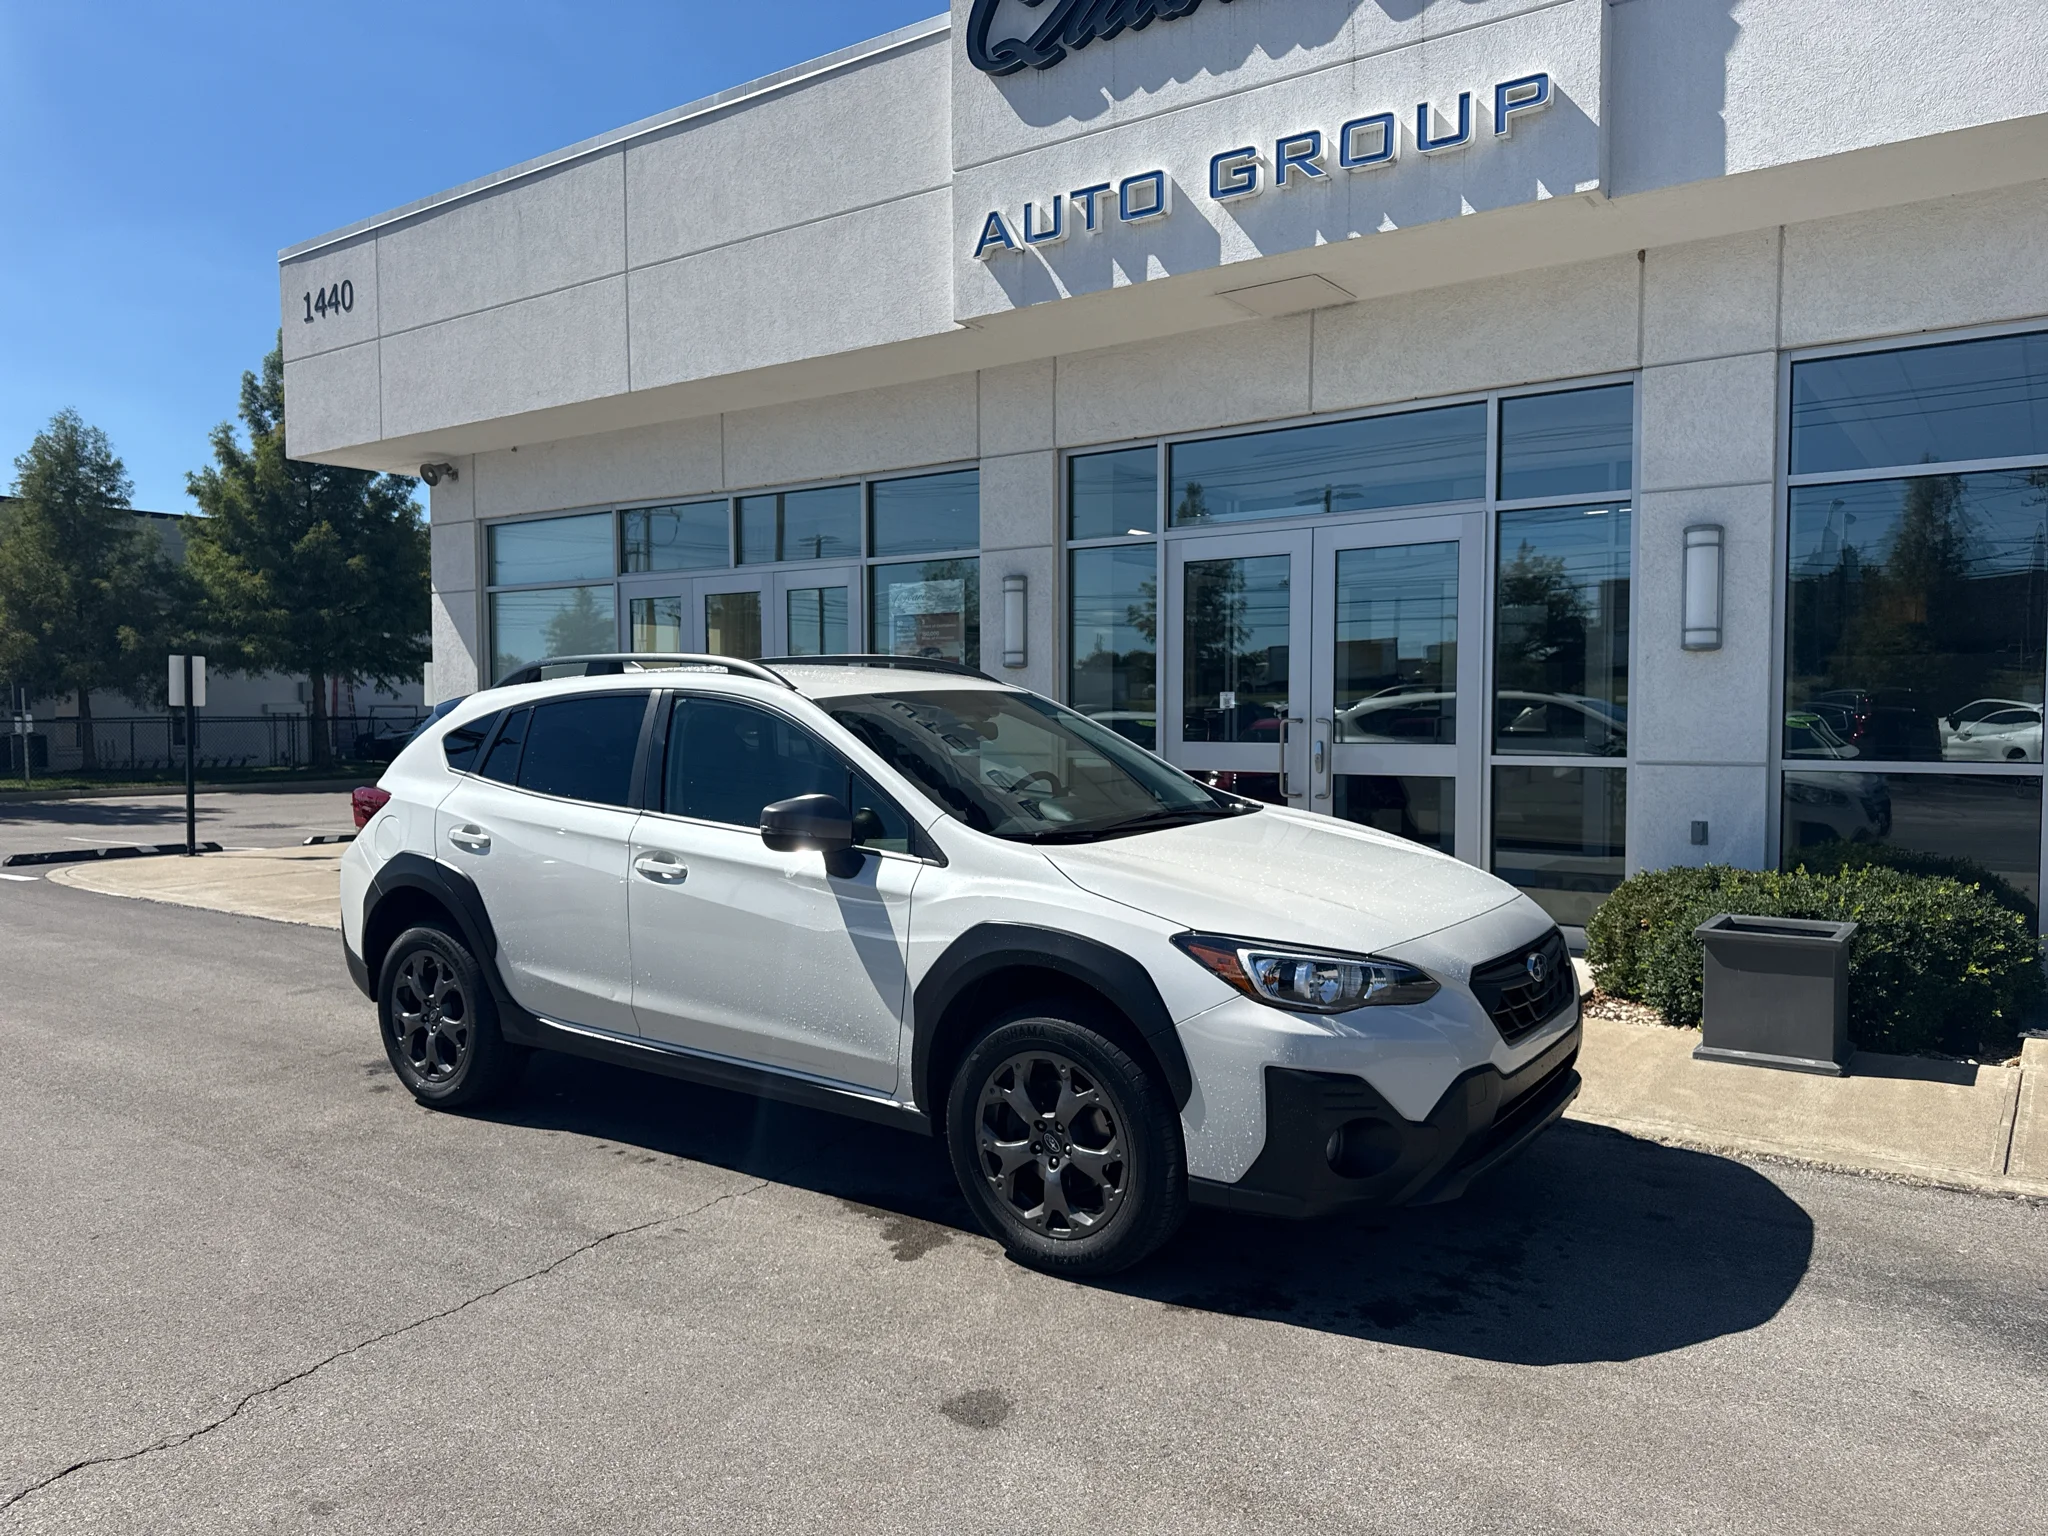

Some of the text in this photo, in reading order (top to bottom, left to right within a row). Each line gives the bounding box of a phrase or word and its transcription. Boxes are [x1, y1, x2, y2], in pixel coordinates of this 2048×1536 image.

[973, 72, 1554, 260] AUTO GROUP
[303, 279, 354, 324] 1440
